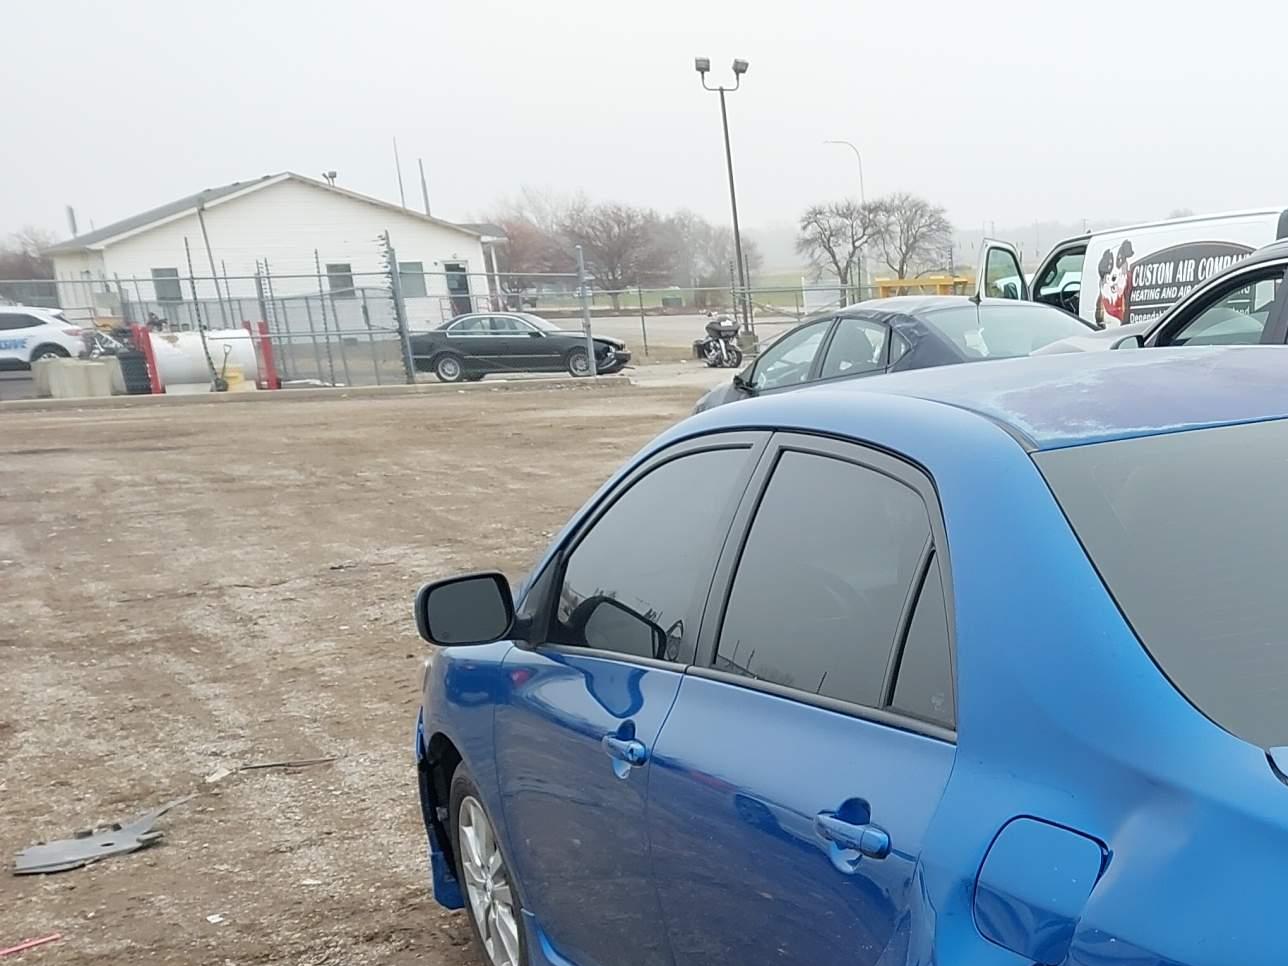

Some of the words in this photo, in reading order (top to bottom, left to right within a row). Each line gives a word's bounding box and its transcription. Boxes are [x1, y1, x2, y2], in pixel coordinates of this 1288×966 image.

[1132, 262, 1174, 287] CUSTOM
[1176, 259, 1196, 282] AIR
[1130, 288, 1160, 302] HEATING
[1161, 286, 1178, 299] AND
